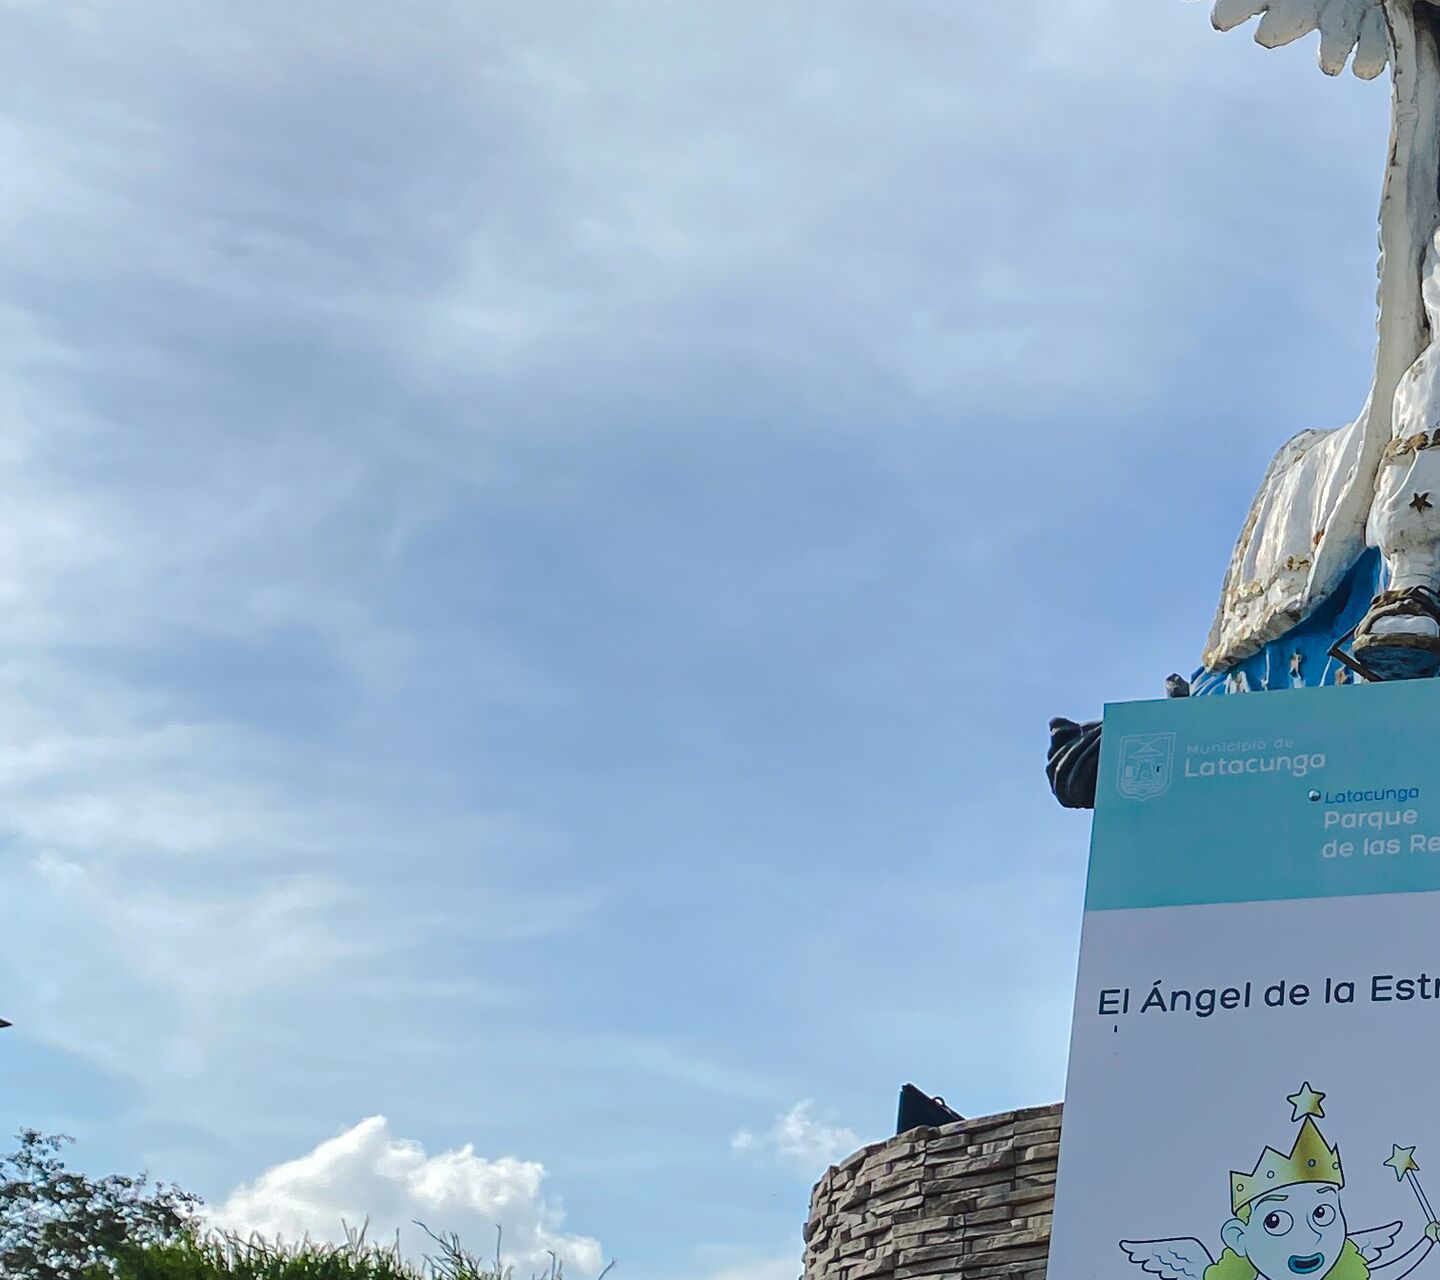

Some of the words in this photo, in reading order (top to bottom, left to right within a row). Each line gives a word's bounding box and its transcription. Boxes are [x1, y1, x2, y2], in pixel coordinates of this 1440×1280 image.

[1187, 739, 1267, 755] Municipio
[1274, 737, 1294, 749] de
[1184, 753, 1326, 777] Latacunga
[1325, 787, 1420, 804] Latacunga
[1324, 809, 1418, 830] Parque
[1322, 839, 1354, 858] de
[1363, 837, 1400, 856] las
[1098, 988, 1129, 1015] El
[1140, 980, 1252, 1018] Ángel
[1264, 980, 1310, 1007] de
[1325, 978, 1355, 1004] la
